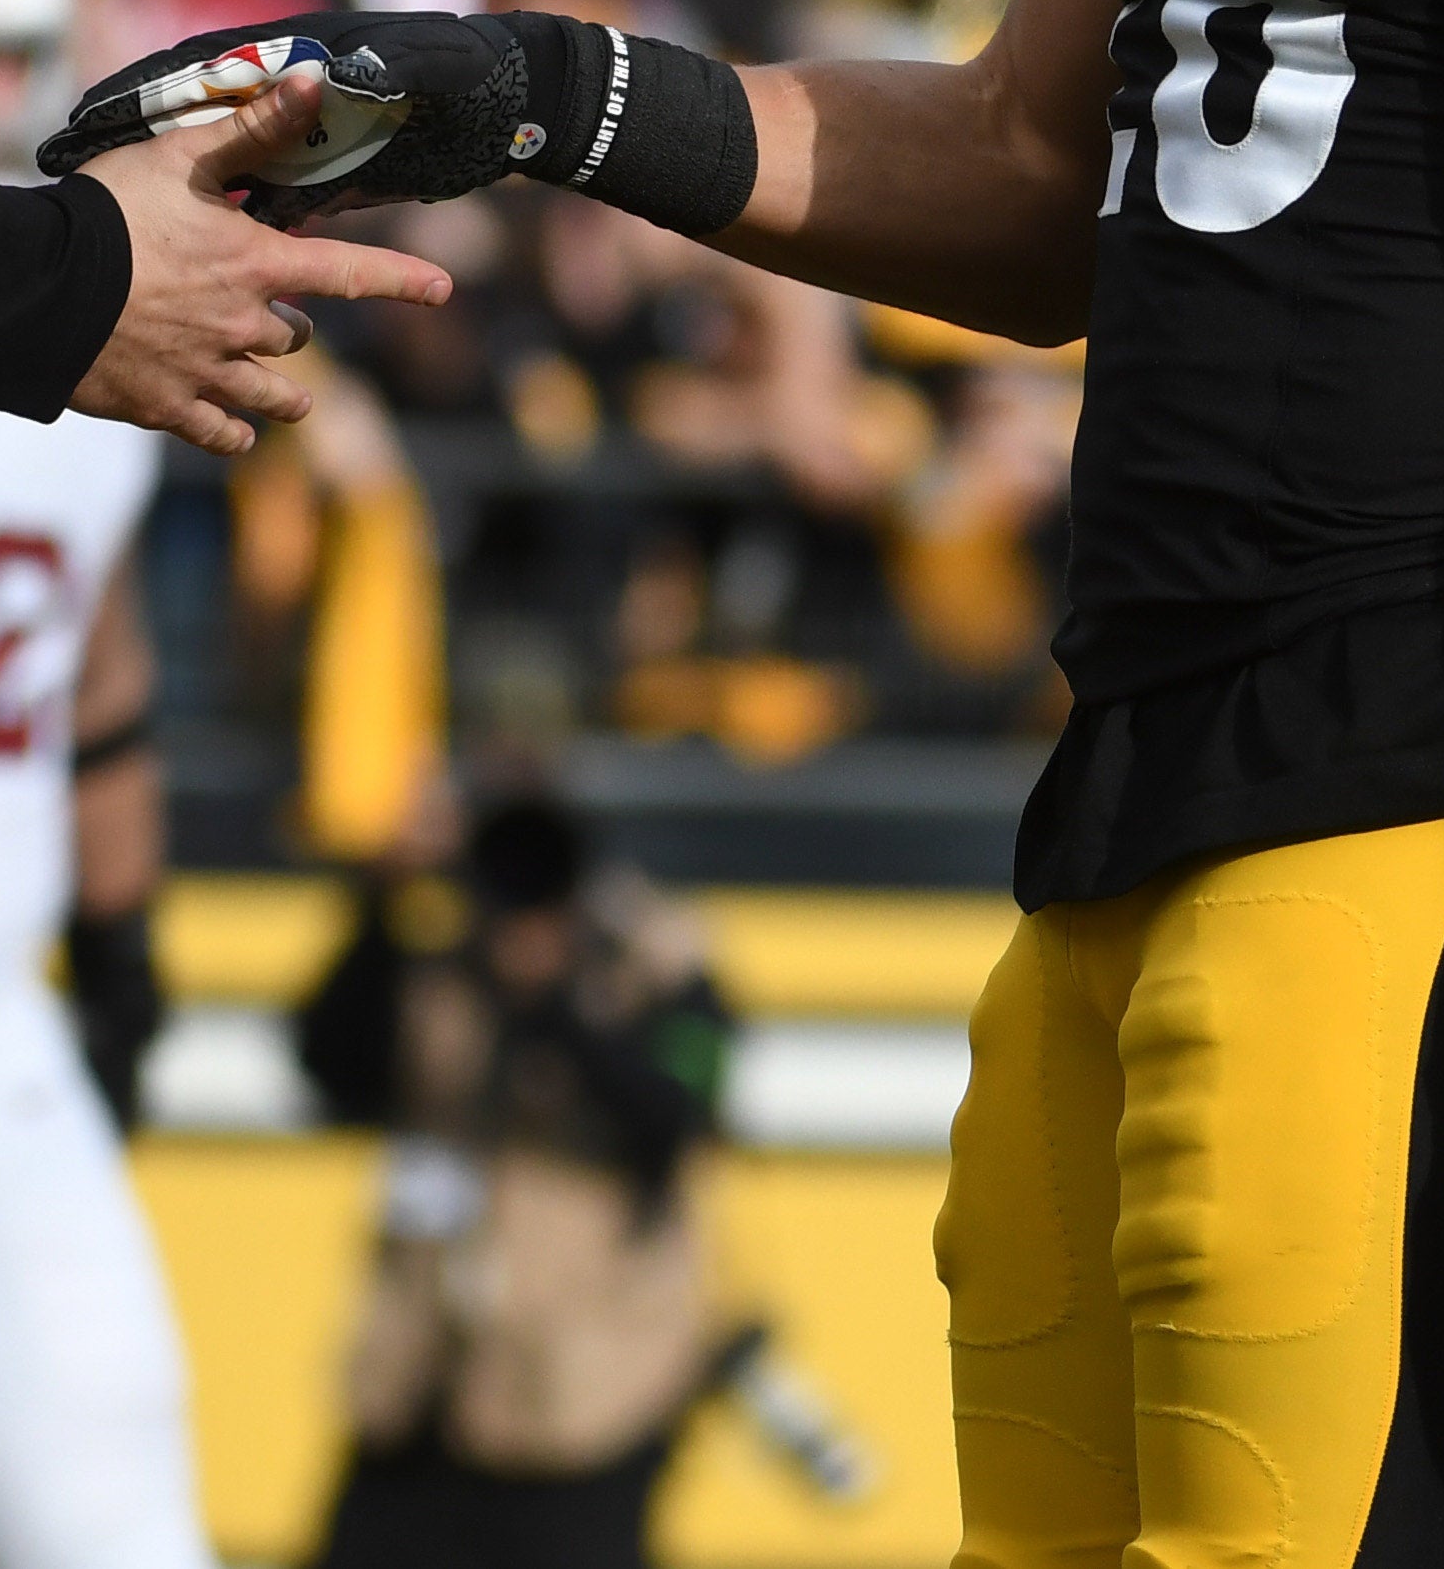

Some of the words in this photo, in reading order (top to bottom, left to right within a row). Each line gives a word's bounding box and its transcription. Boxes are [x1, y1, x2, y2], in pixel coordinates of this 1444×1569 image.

[612, 56, 630, 89] THE
[607, 90, 625, 116] OF
[585, 117, 618, 166] LIGHT
